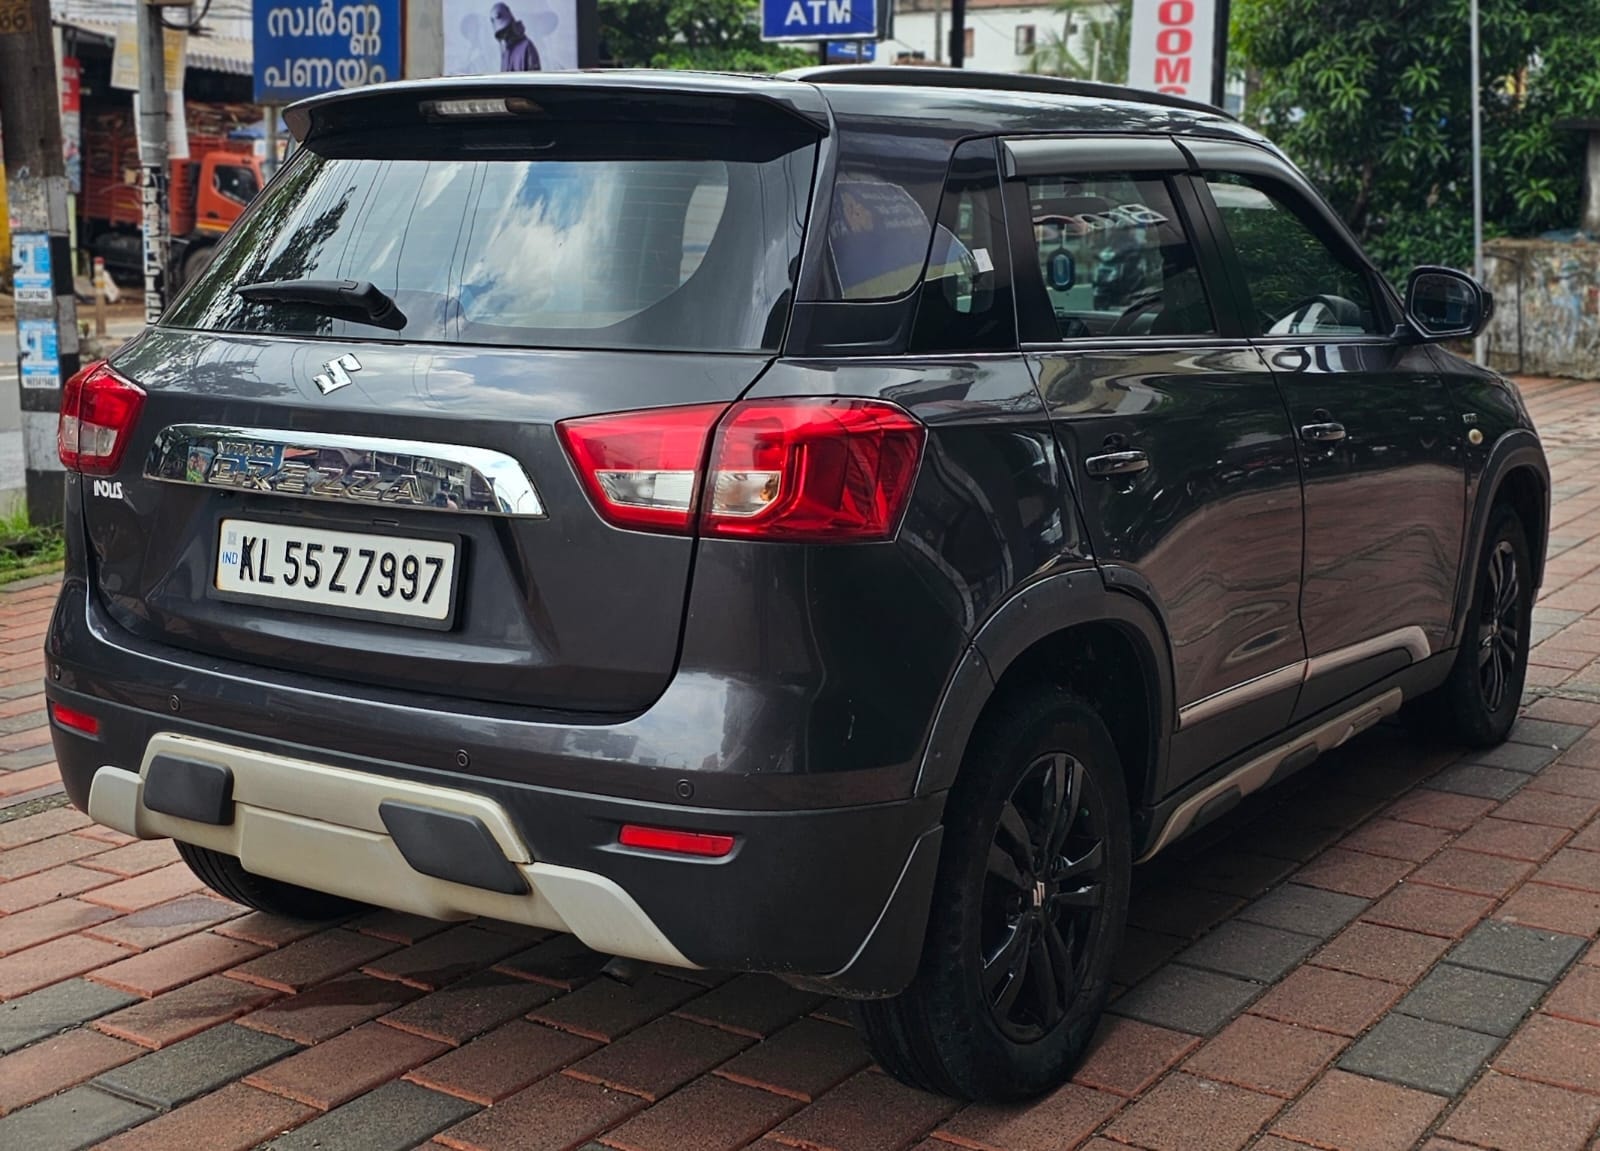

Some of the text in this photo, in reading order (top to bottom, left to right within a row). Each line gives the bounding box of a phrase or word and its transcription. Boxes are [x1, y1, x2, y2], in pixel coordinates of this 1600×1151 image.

[784, 0, 852, 26] ATM
[264, 58, 387, 89] പണയം
[216, 440, 276, 459] VITARA
[93, 479, 123, 500] INDUS
[222, 551, 238, 566] IND
